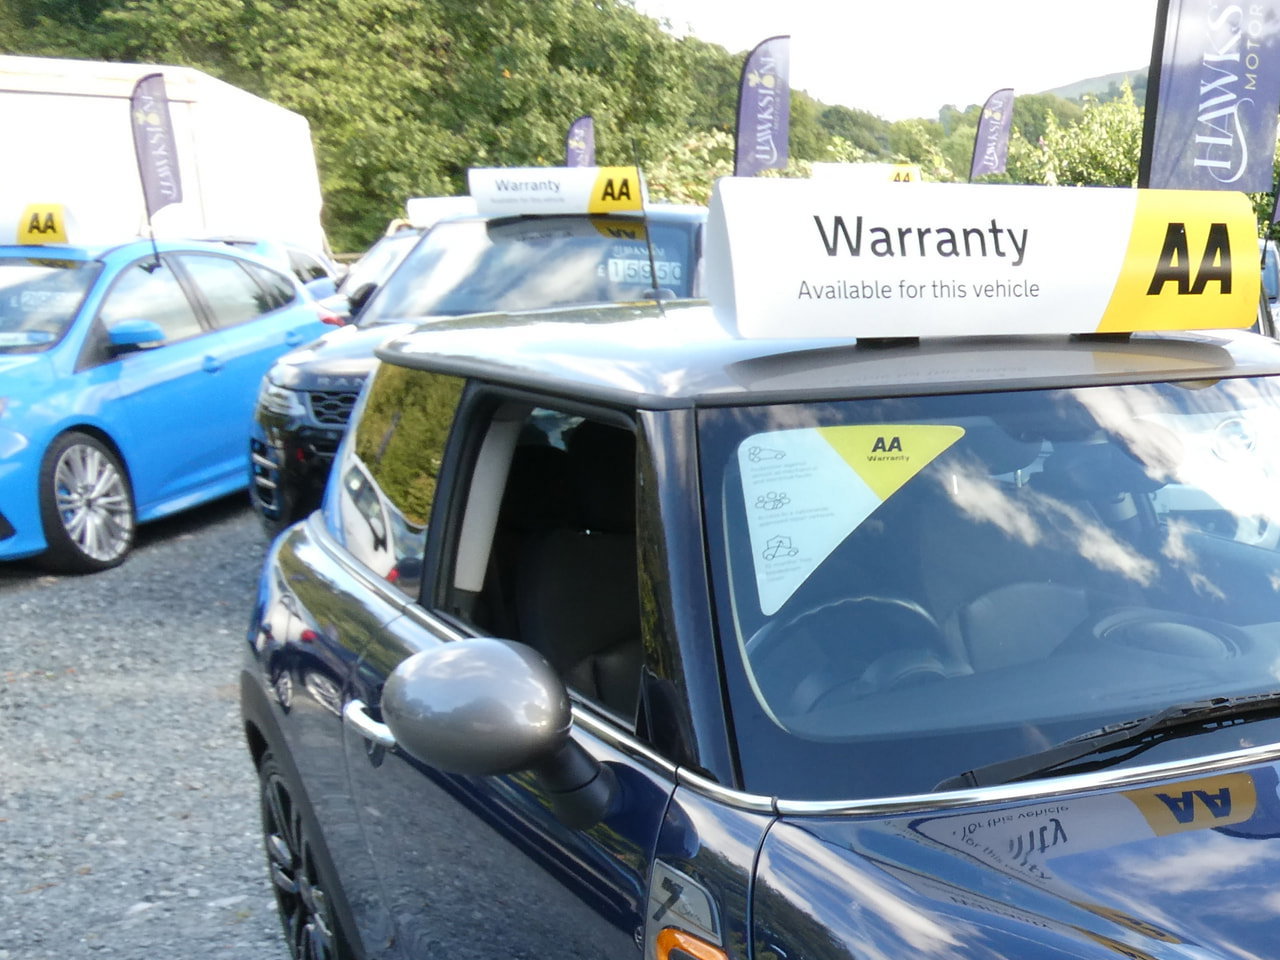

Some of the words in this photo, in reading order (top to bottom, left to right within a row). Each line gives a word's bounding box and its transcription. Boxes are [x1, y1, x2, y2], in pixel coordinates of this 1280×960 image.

[1244, 4, 1264, 91] MOTOR
[495, 178, 561, 193] Warranty
[601, 178, 632, 201] AA
[28, 212, 57, 234] AA
[813, 214, 1029, 267] Warranty
[1146, 222, 1233, 296] AA
[798, 279, 893, 300] Available
[898, 279, 927, 299] for
[931, 279, 967, 298] this
[972, 278, 1040, 299] vehicle
[871, 436, 903, 453] AA
[867, 455, 910, 463] Warranty
